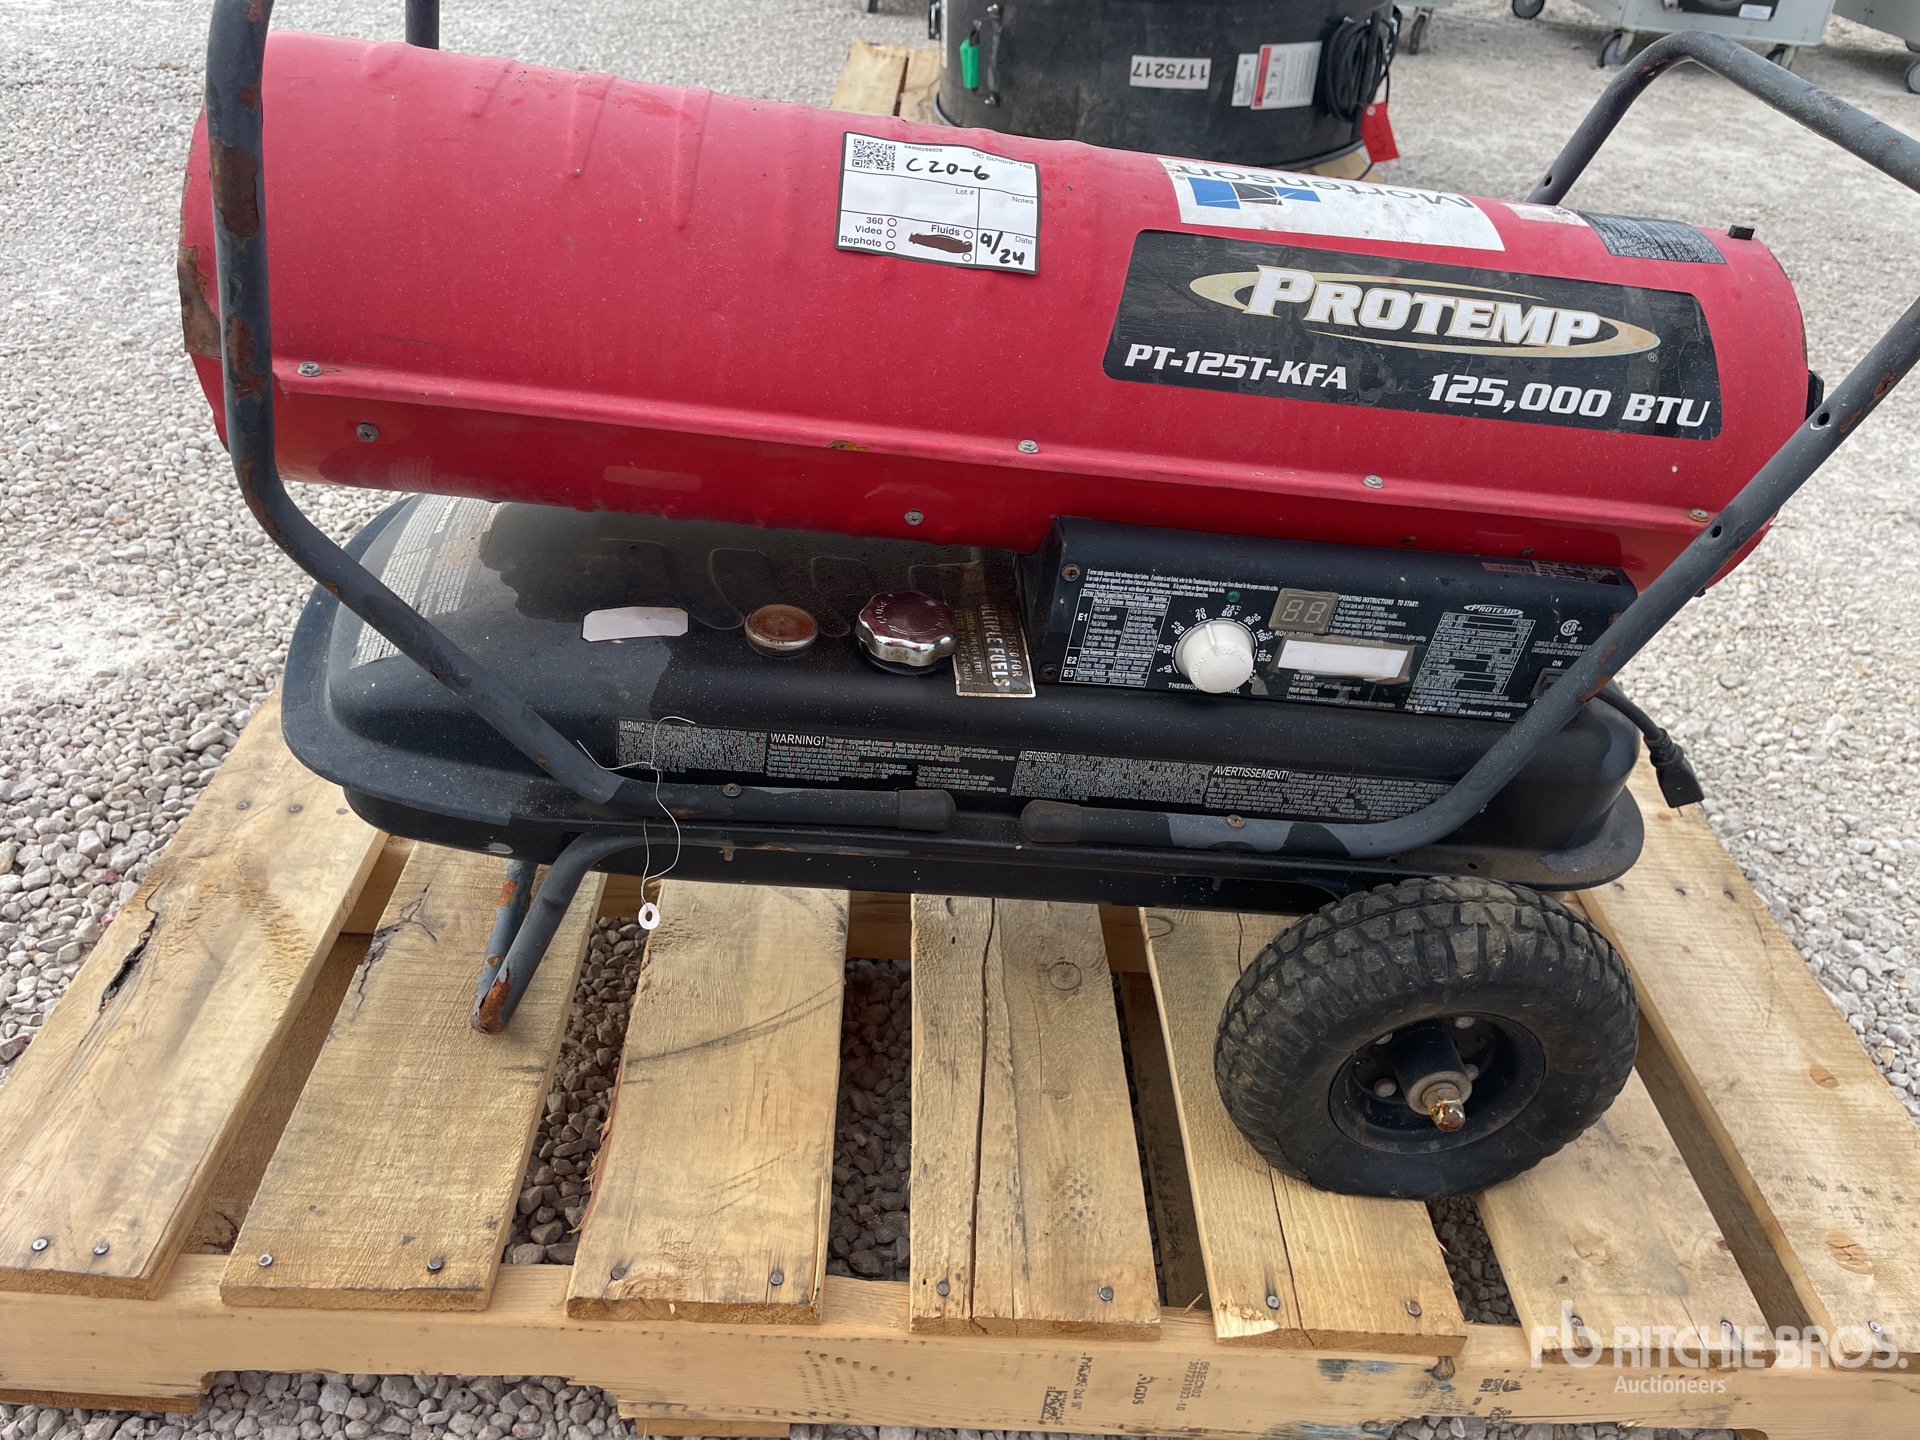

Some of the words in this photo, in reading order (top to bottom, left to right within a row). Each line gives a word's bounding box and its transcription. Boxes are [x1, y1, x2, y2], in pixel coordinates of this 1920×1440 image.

[1132, 61, 1207, 80] 1175217
[955, 188, 969, 196] Lot
[1169, 163, 1475, 210] Mortenson
[1011, 196, 1034, 205] Notes
[866, 217, 883, 225] 360
[855, 225, 882, 235] Video
[931, 225, 960, 236] Fluids
[840, 235, 882, 248] Rephoto
[1015, 235, 1033, 246] Date
[1242, 264, 1600, 348] PROTEMP
[1124, 343, 1349, 391] PT-125T-KFA
[1428, 373, 1613, 419] 125,000
[1622, 393, 1711, 428] BTU
[1471, 604, 1518, 615] PROTEMP
[1077, 613, 1088, 621] E1
[1196, 613, 1207, 621] 70
[1244, 616, 1254, 625] 90
[1251, 613, 1261, 621] 30
[1174, 625, 1185, 635] 60
[1256, 629, 1267, 642] 100
[1163, 644, 1172, 654] 50
[1066, 656, 1077, 664] E2
[1257, 649, 1267, 662] 105
[988, 647, 1011, 687] FUELS
[1010, 658, 1023, 677] FOR
[1063, 669, 1074, 677] E3
[619, 720, 645, 733] WARNING
[770, 733, 824, 746] WARNING!
[1213, 765, 1288, 780] AVERTISSEMENT!
